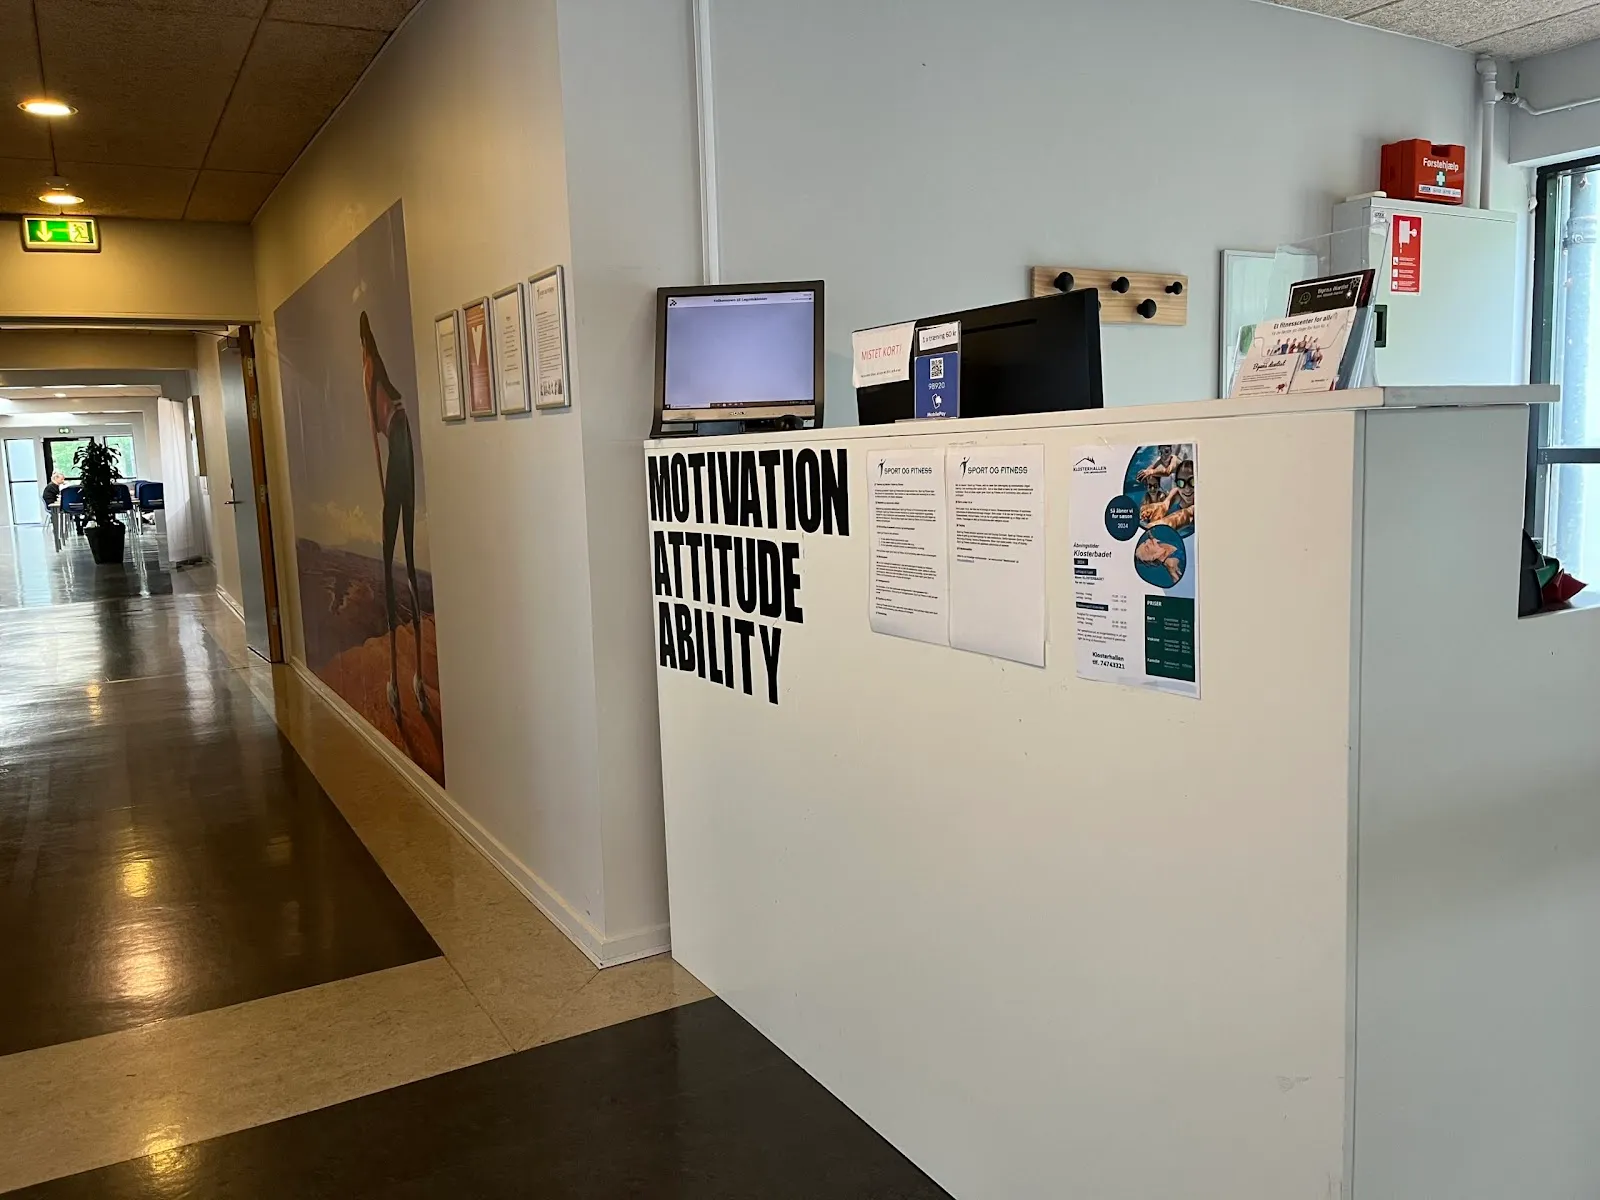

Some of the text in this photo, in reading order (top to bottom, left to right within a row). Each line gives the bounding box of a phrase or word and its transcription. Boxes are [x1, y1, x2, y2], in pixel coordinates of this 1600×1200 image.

[1280, 318, 1313, 327] fitnesscenter
[946, 330, 952, 338] 60
[861, 347, 882, 361] MISTET
[967, 466, 1028, 474] SPORT OG FITNESS
[648, 448, 849, 536] MOTIVATION
[1073, 549, 1112, 558] Klosterbadet
[654, 531, 803, 624] ATTITUDE
[659, 601, 782, 705] ABILITY
[1092, 651, 1125, 661] Klosterhallen
